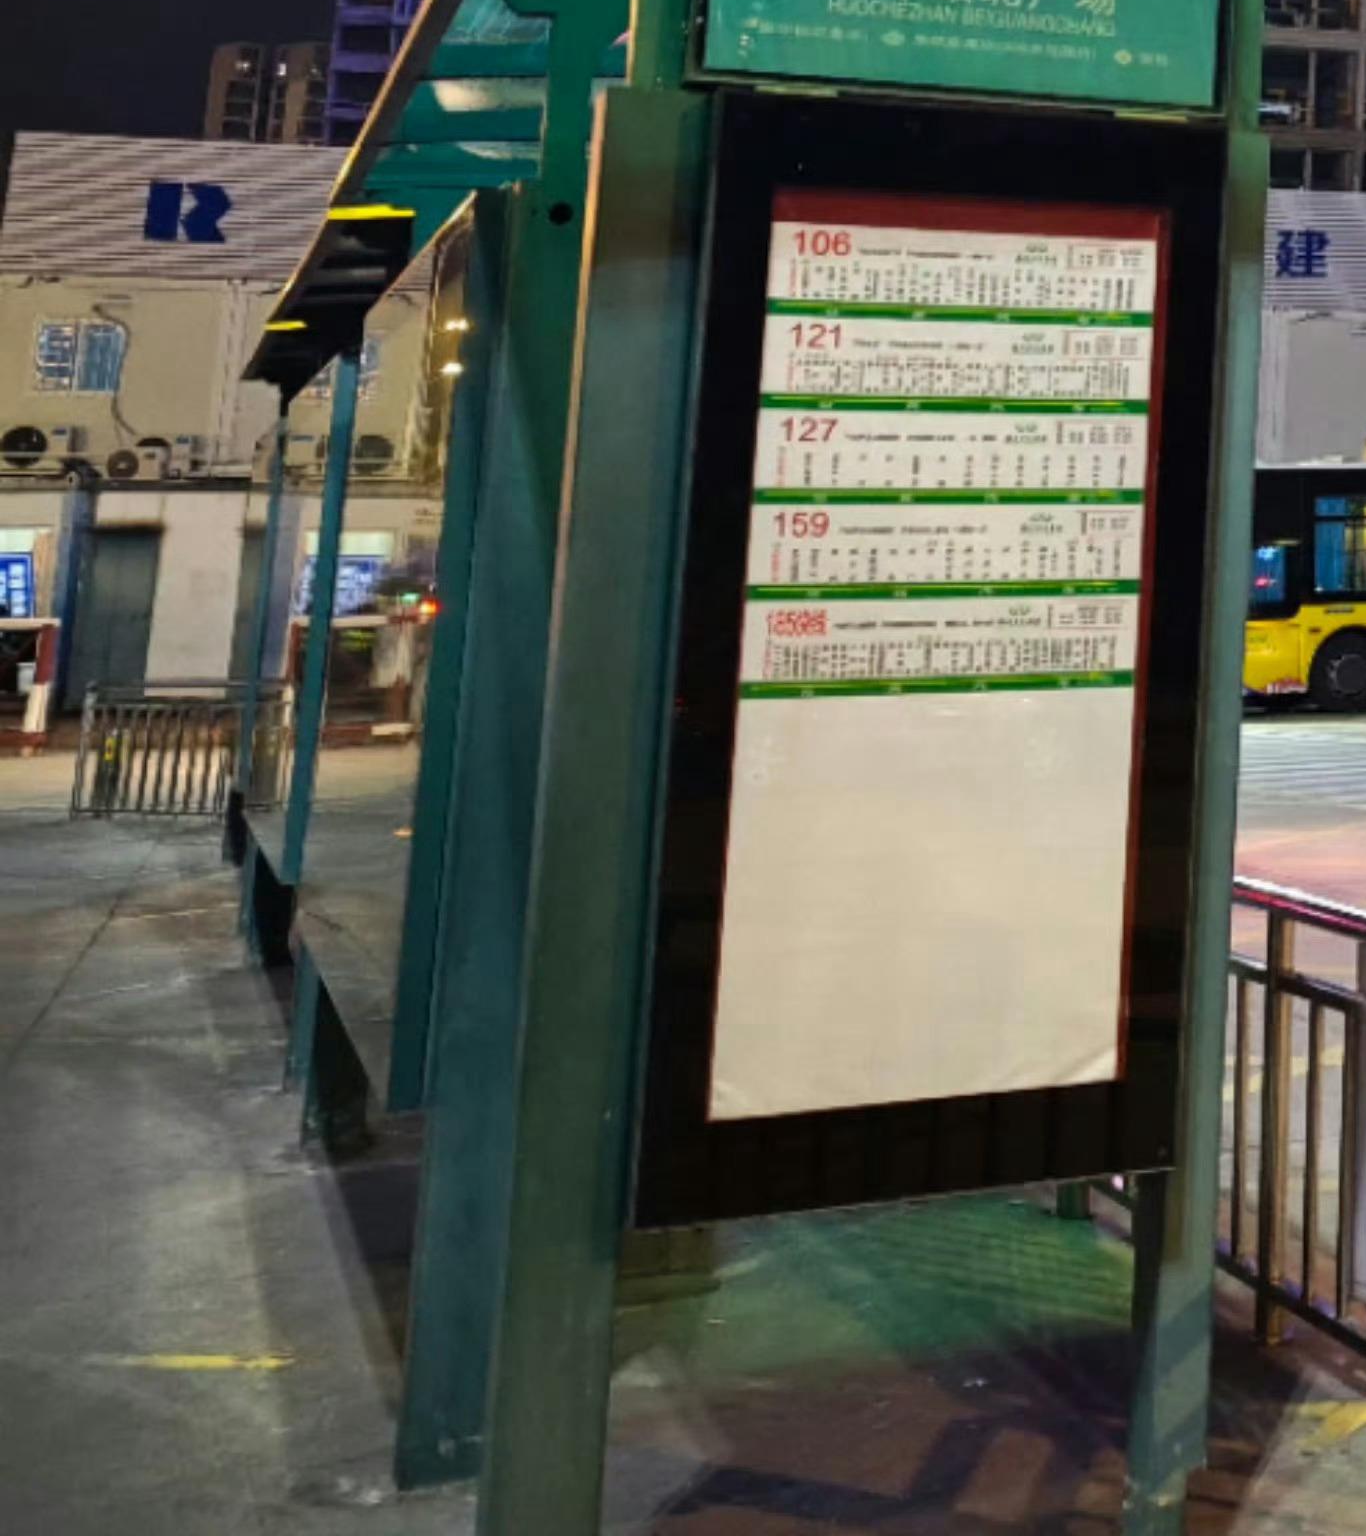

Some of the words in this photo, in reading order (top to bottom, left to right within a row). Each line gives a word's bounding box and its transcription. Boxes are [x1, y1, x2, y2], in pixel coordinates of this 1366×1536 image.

[793, 229, 852, 257] 106
[789, 323, 843, 350] 121
[780, 418, 839, 443] 127
[773, 512, 831, 539] 159
